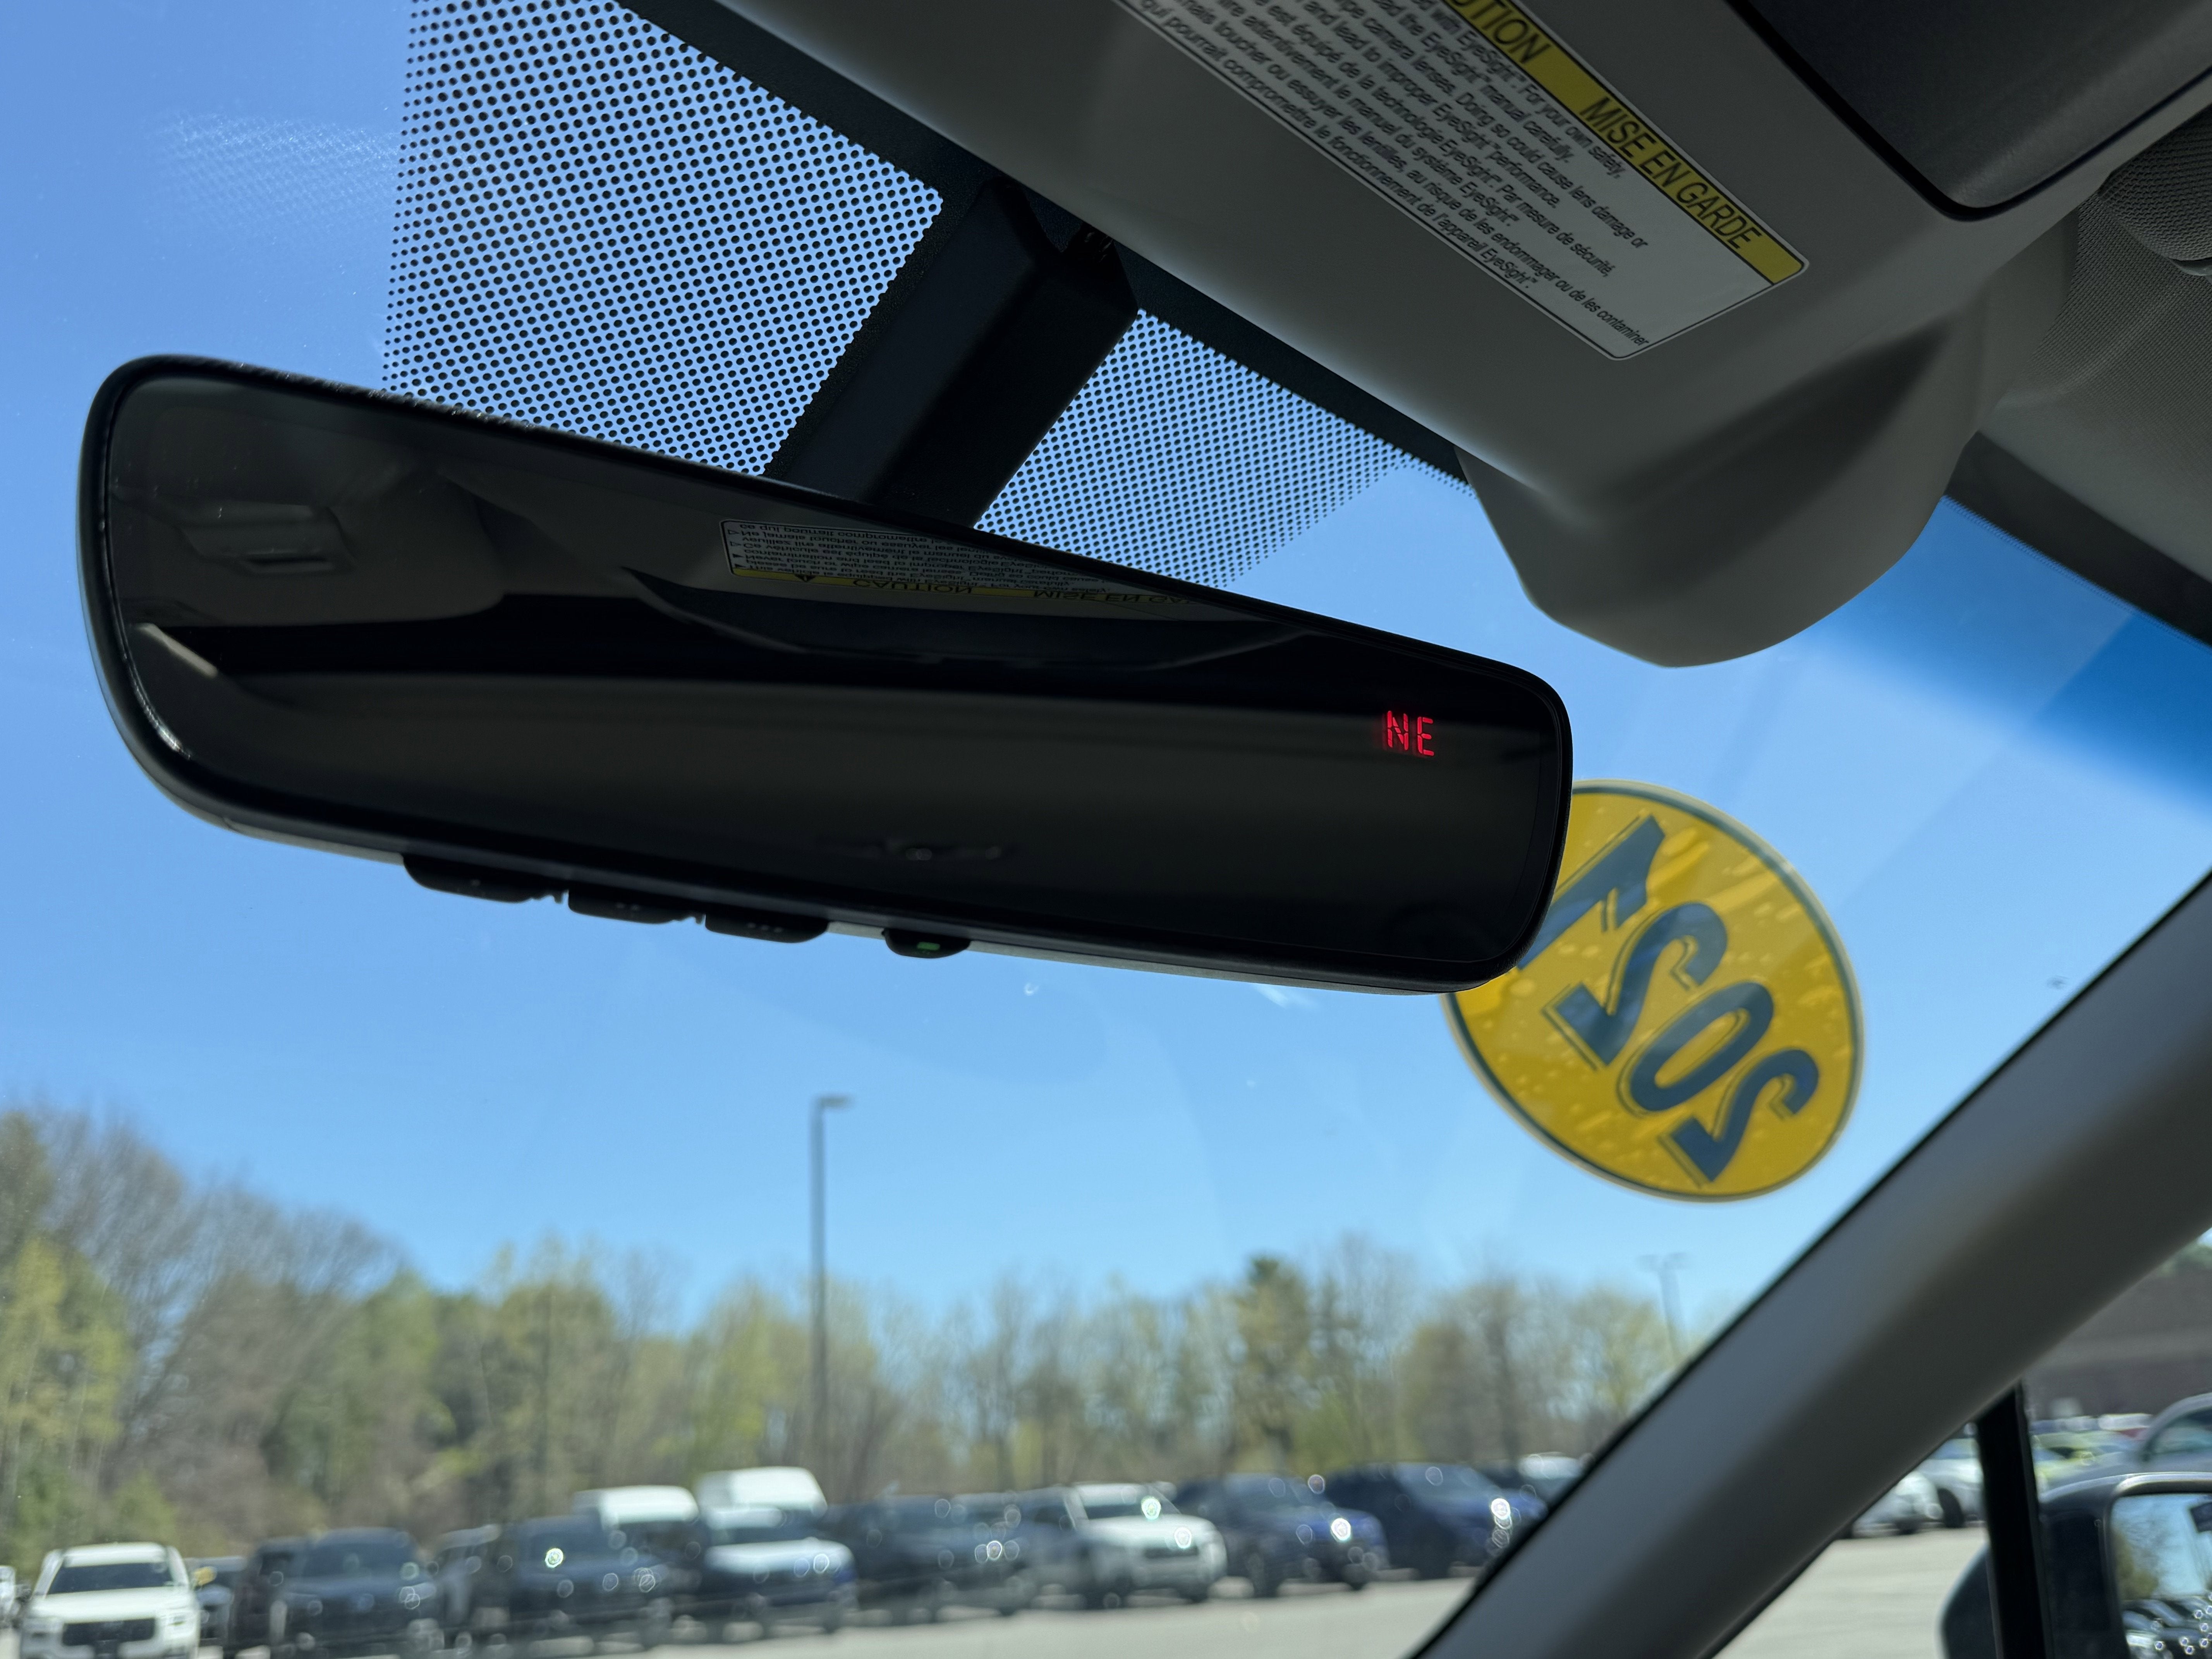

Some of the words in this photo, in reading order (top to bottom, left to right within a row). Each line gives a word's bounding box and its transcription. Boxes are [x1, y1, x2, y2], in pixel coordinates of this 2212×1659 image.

[1222, 59, 1318, 129] compromettre
[1312, 124, 1332, 139] le
[1326, 135, 1424, 206] fonctionnement
[1416, 203, 1437, 217] de
[1431, 212, 1489, 252] l'appareil
[1290, 23, 1346, 64] équipé
[1337, 61, 1362, 79] de
[1356, 74, 1376, 91] la
[1370, 86, 1448, 145] technologie
[1495, 184, 1523, 204] Par
[1515, 201, 1561, 235] mesure
[1555, 232, 1575, 246] de
[1569, 243, 1616, 277] sécurité,
[1302, 0, 1341, 26] and
[1330, 20, 1372, 51] lead
[1361, 46, 1382, 63] to
[1376, 58, 1439, 106] improper
[1484, 148, 1561, 209] performance.
[1332, 84, 1352, 100] le
[1346, 97, 1404, 136] manuel
[1394, 133, 1417, 149] du
[1410, 146, 1464, 185] système
[1361, 17, 1417, 61] camera
[1410, 55, 1458, 97] lenses.
[1454, 91, 1497, 128] Doing
[1489, 123, 1512, 139] so
[1505, 136, 1546, 164] could
[1536, 161, 1574, 190] cause
[1568, 185, 1597, 209] lens
[1591, 206, 1636, 240] damage
[1630, 237, 1649, 249] or
[1397, 12, 1426, 36] the
[1479, 81, 1532, 123] manual
[1522, 120, 1575, 163] carefully.
[1429, 8, 1462, 36] with
[1517, 83, 1547, 106] For
[1534, 103, 1572, 128] your
[1564, 126, 1594, 149] own
[1587, 145, 1626, 179] safety,
[1578, 95, 1658, 159] MISE
[1637, 149, 1692, 188] EN
[1675, 181, 1763, 250] GARDE
[1212, 21, 1274, 65] toucher
[1266, 64, 1292, 81] ou
[1286, 79, 1345, 119] essuyer
[1336, 115, 1363, 136] les
[1357, 131, 1408, 173] lentilles,
[1405, 170, 1429, 184] au
[1422, 181, 1463, 210] risque
[1458, 208, 1479, 222] de
[1472, 217, 1496, 235] les
[1490, 232, 1561, 282] endommager
[1554, 280, 1574, 292] ou
[1568, 290, 1587, 302] de
[1580, 297, 1601, 313] les
[1596, 310, 1650, 346] contaminer
[1387, 710, 1434, 756] NE
